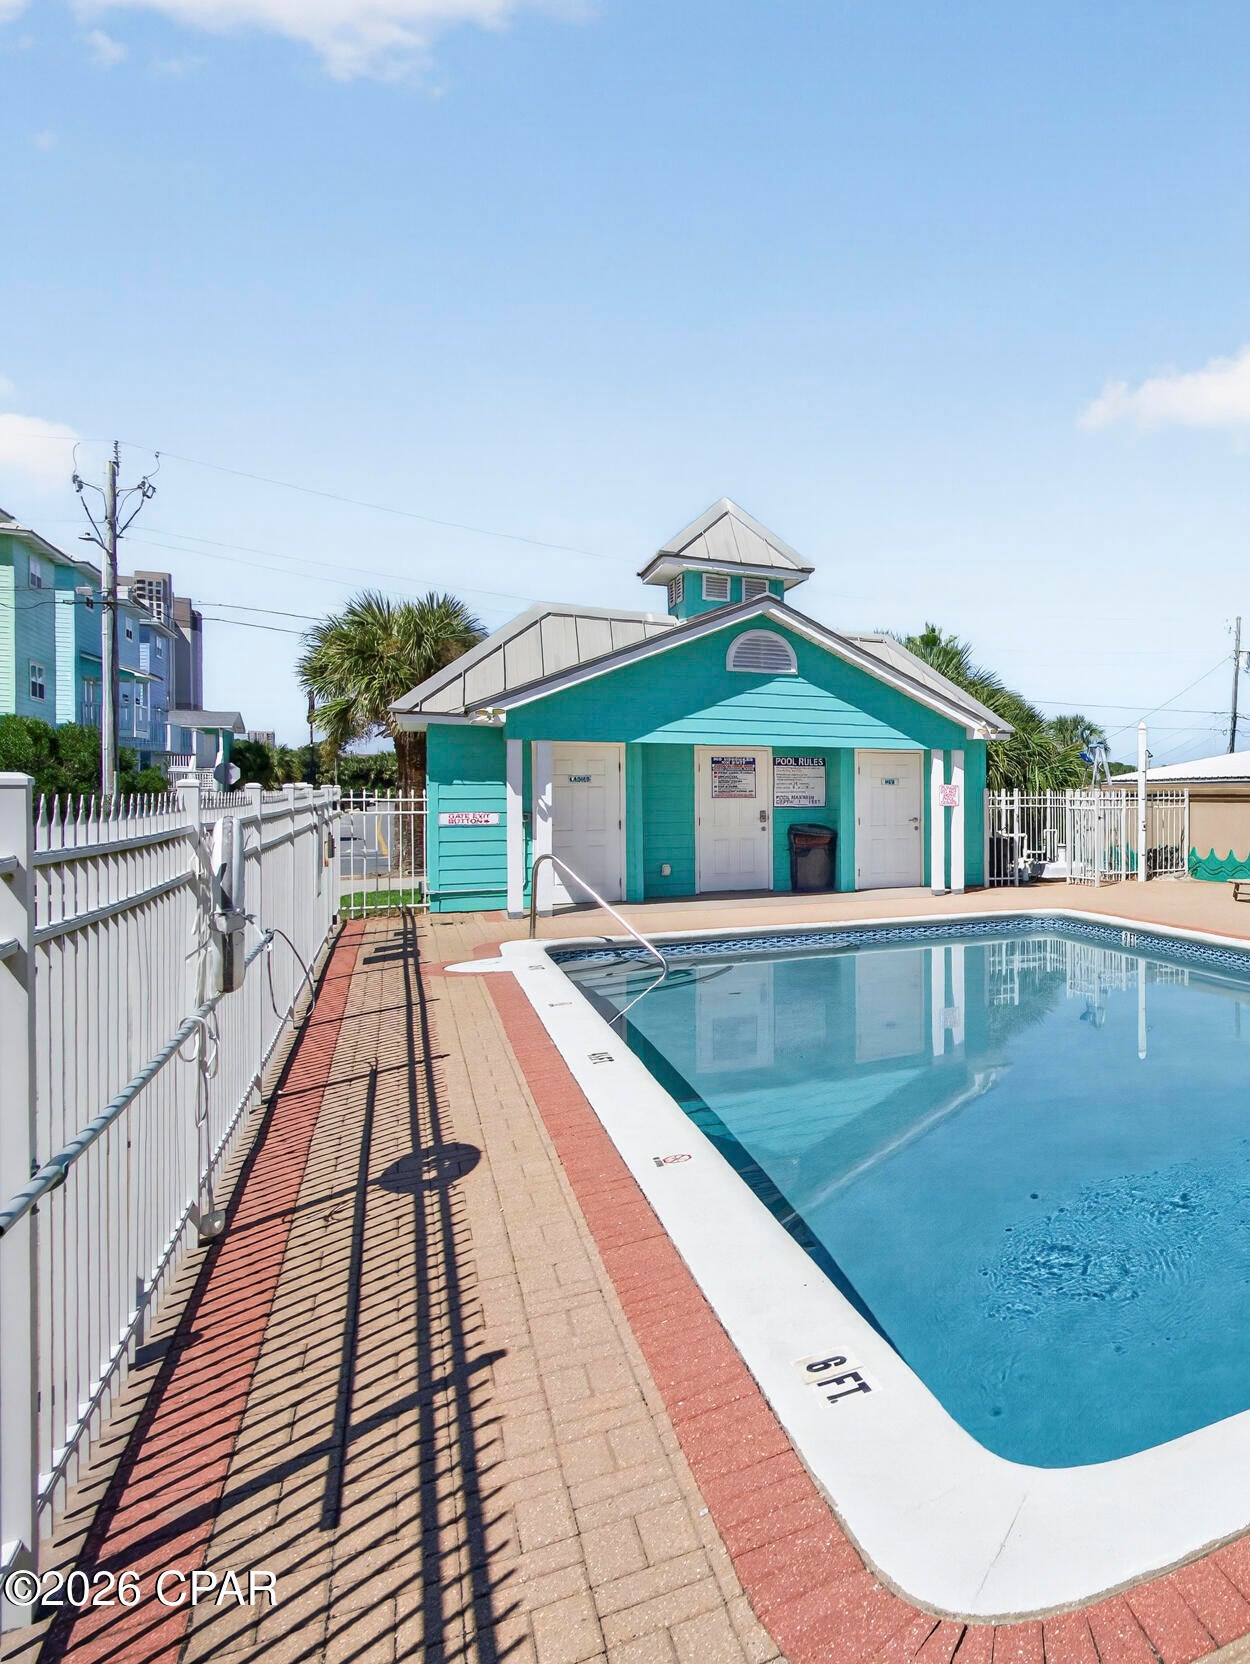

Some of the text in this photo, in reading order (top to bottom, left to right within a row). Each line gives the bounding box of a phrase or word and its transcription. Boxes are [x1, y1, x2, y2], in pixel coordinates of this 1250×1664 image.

[775, 757, 824, 766] POOL RULES
[806, 1355, 848, 1373] 6
